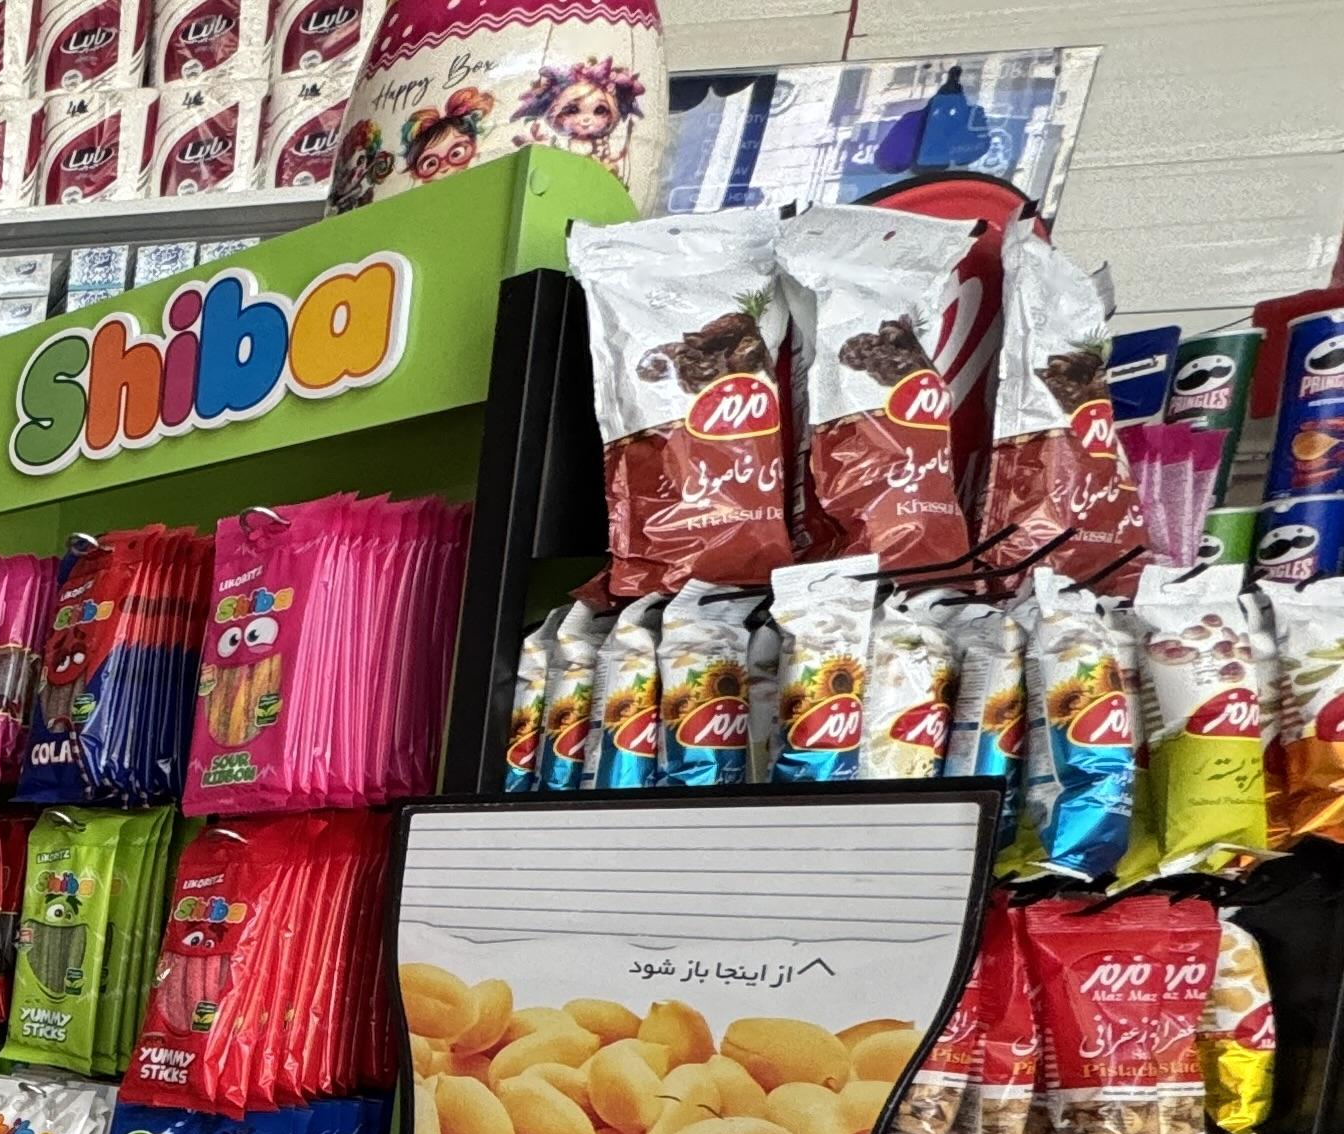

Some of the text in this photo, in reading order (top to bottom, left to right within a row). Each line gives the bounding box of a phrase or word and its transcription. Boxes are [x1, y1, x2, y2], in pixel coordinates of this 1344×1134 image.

[372, 52, 497, 113] Happy Box
[12, 254, 409, 473] Shiba
[1299, 374, 1344, 398] PRING
[703, 380, 769, 433] مزمز
[215, 587, 294, 624] Shiba
[30, 740, 73, 766] COLA
[35, 871, 96, 898] Shiba
[173, 896, 249, 926] Shiba
[628, 958, 794, 988] از اینجا باز شود
[1080, 953, 1152, 994] مزمز
[1092, 989, 1158, 1002] Maz Maz
[18, 1006, 72, 1028] YUMMY
[21, 1022, 68, 1043] STICKS
[138, 1044, 197, 1069] YUMMY
[139, 1061, 189, 1085] STICKS
[1083, 1062, 1159, 1079] Pistach
